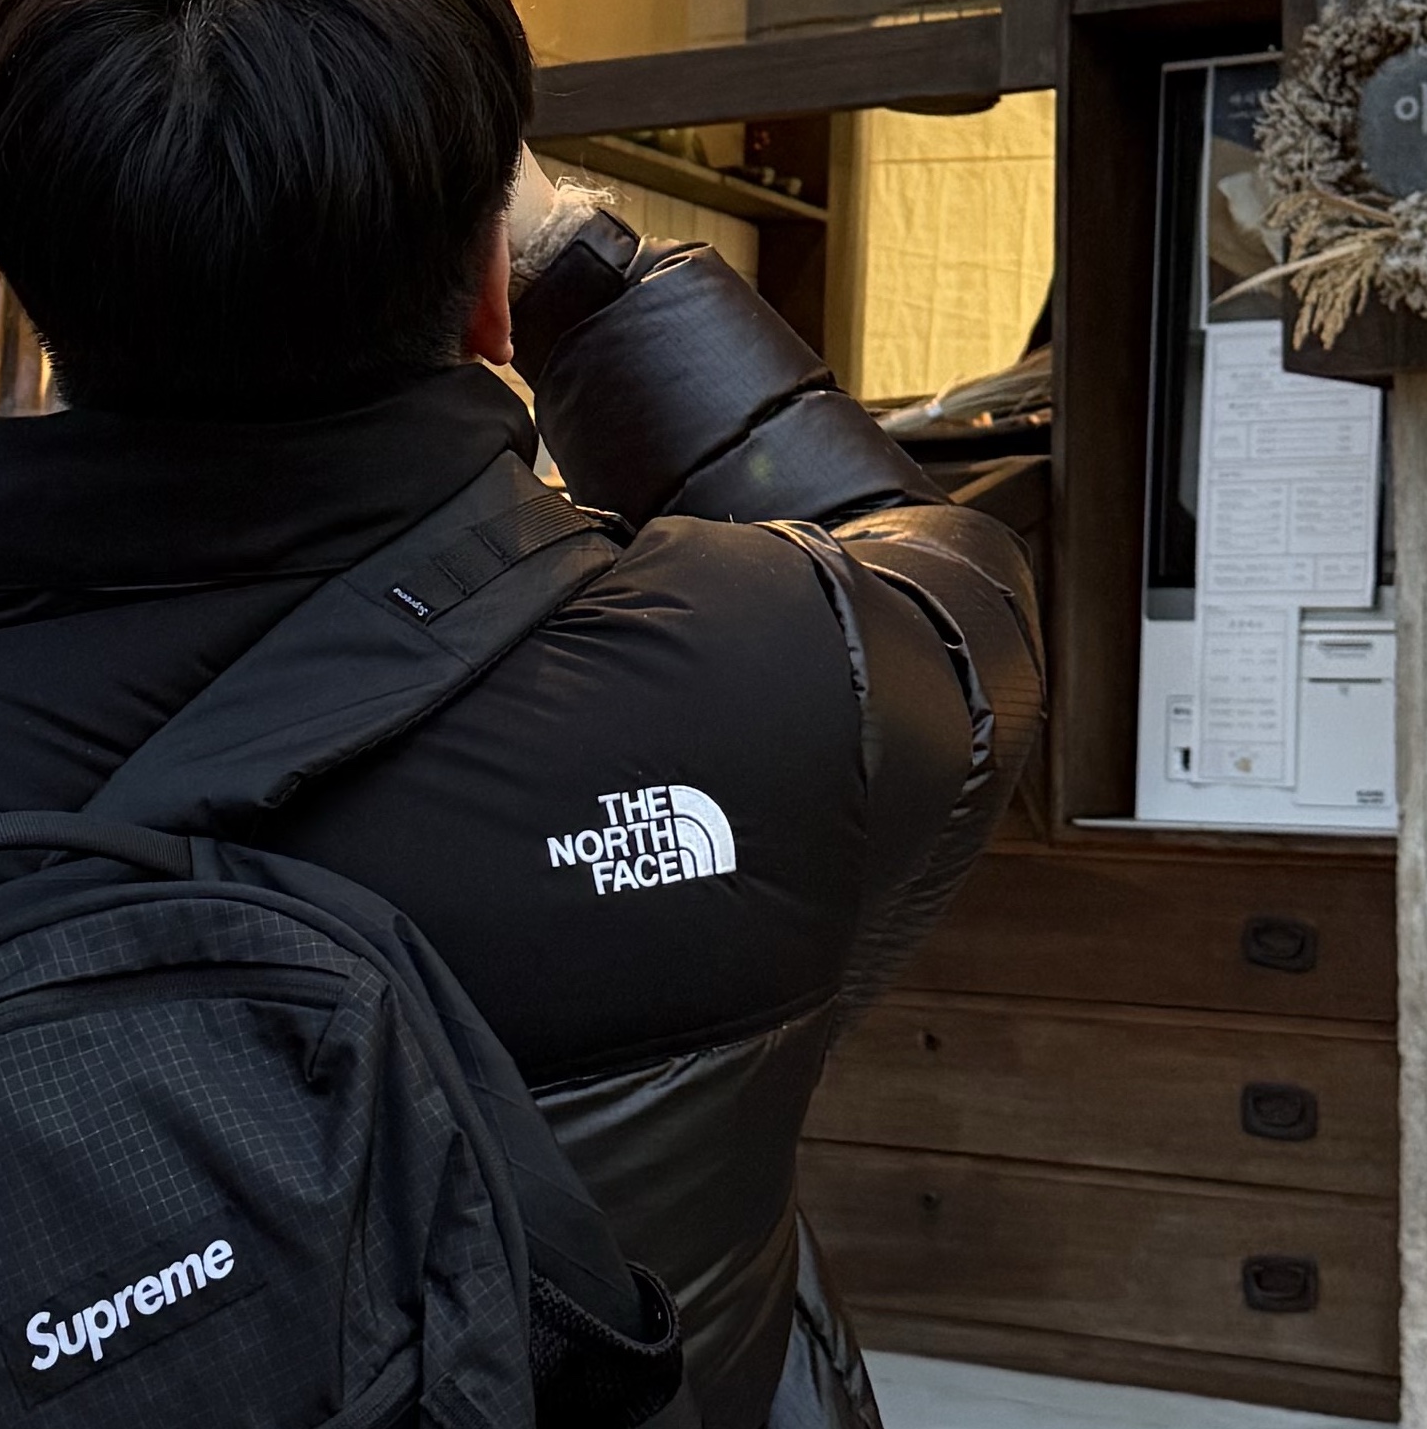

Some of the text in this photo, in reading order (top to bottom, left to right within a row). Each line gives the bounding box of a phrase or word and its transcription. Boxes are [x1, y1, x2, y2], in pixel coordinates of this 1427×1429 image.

[598, 786, 670, 826] THE
[546, 818, 675, 868] NORTH
[592, 850, 682, 895] FACE
[26, 1239, 235, 1370] Supreme
